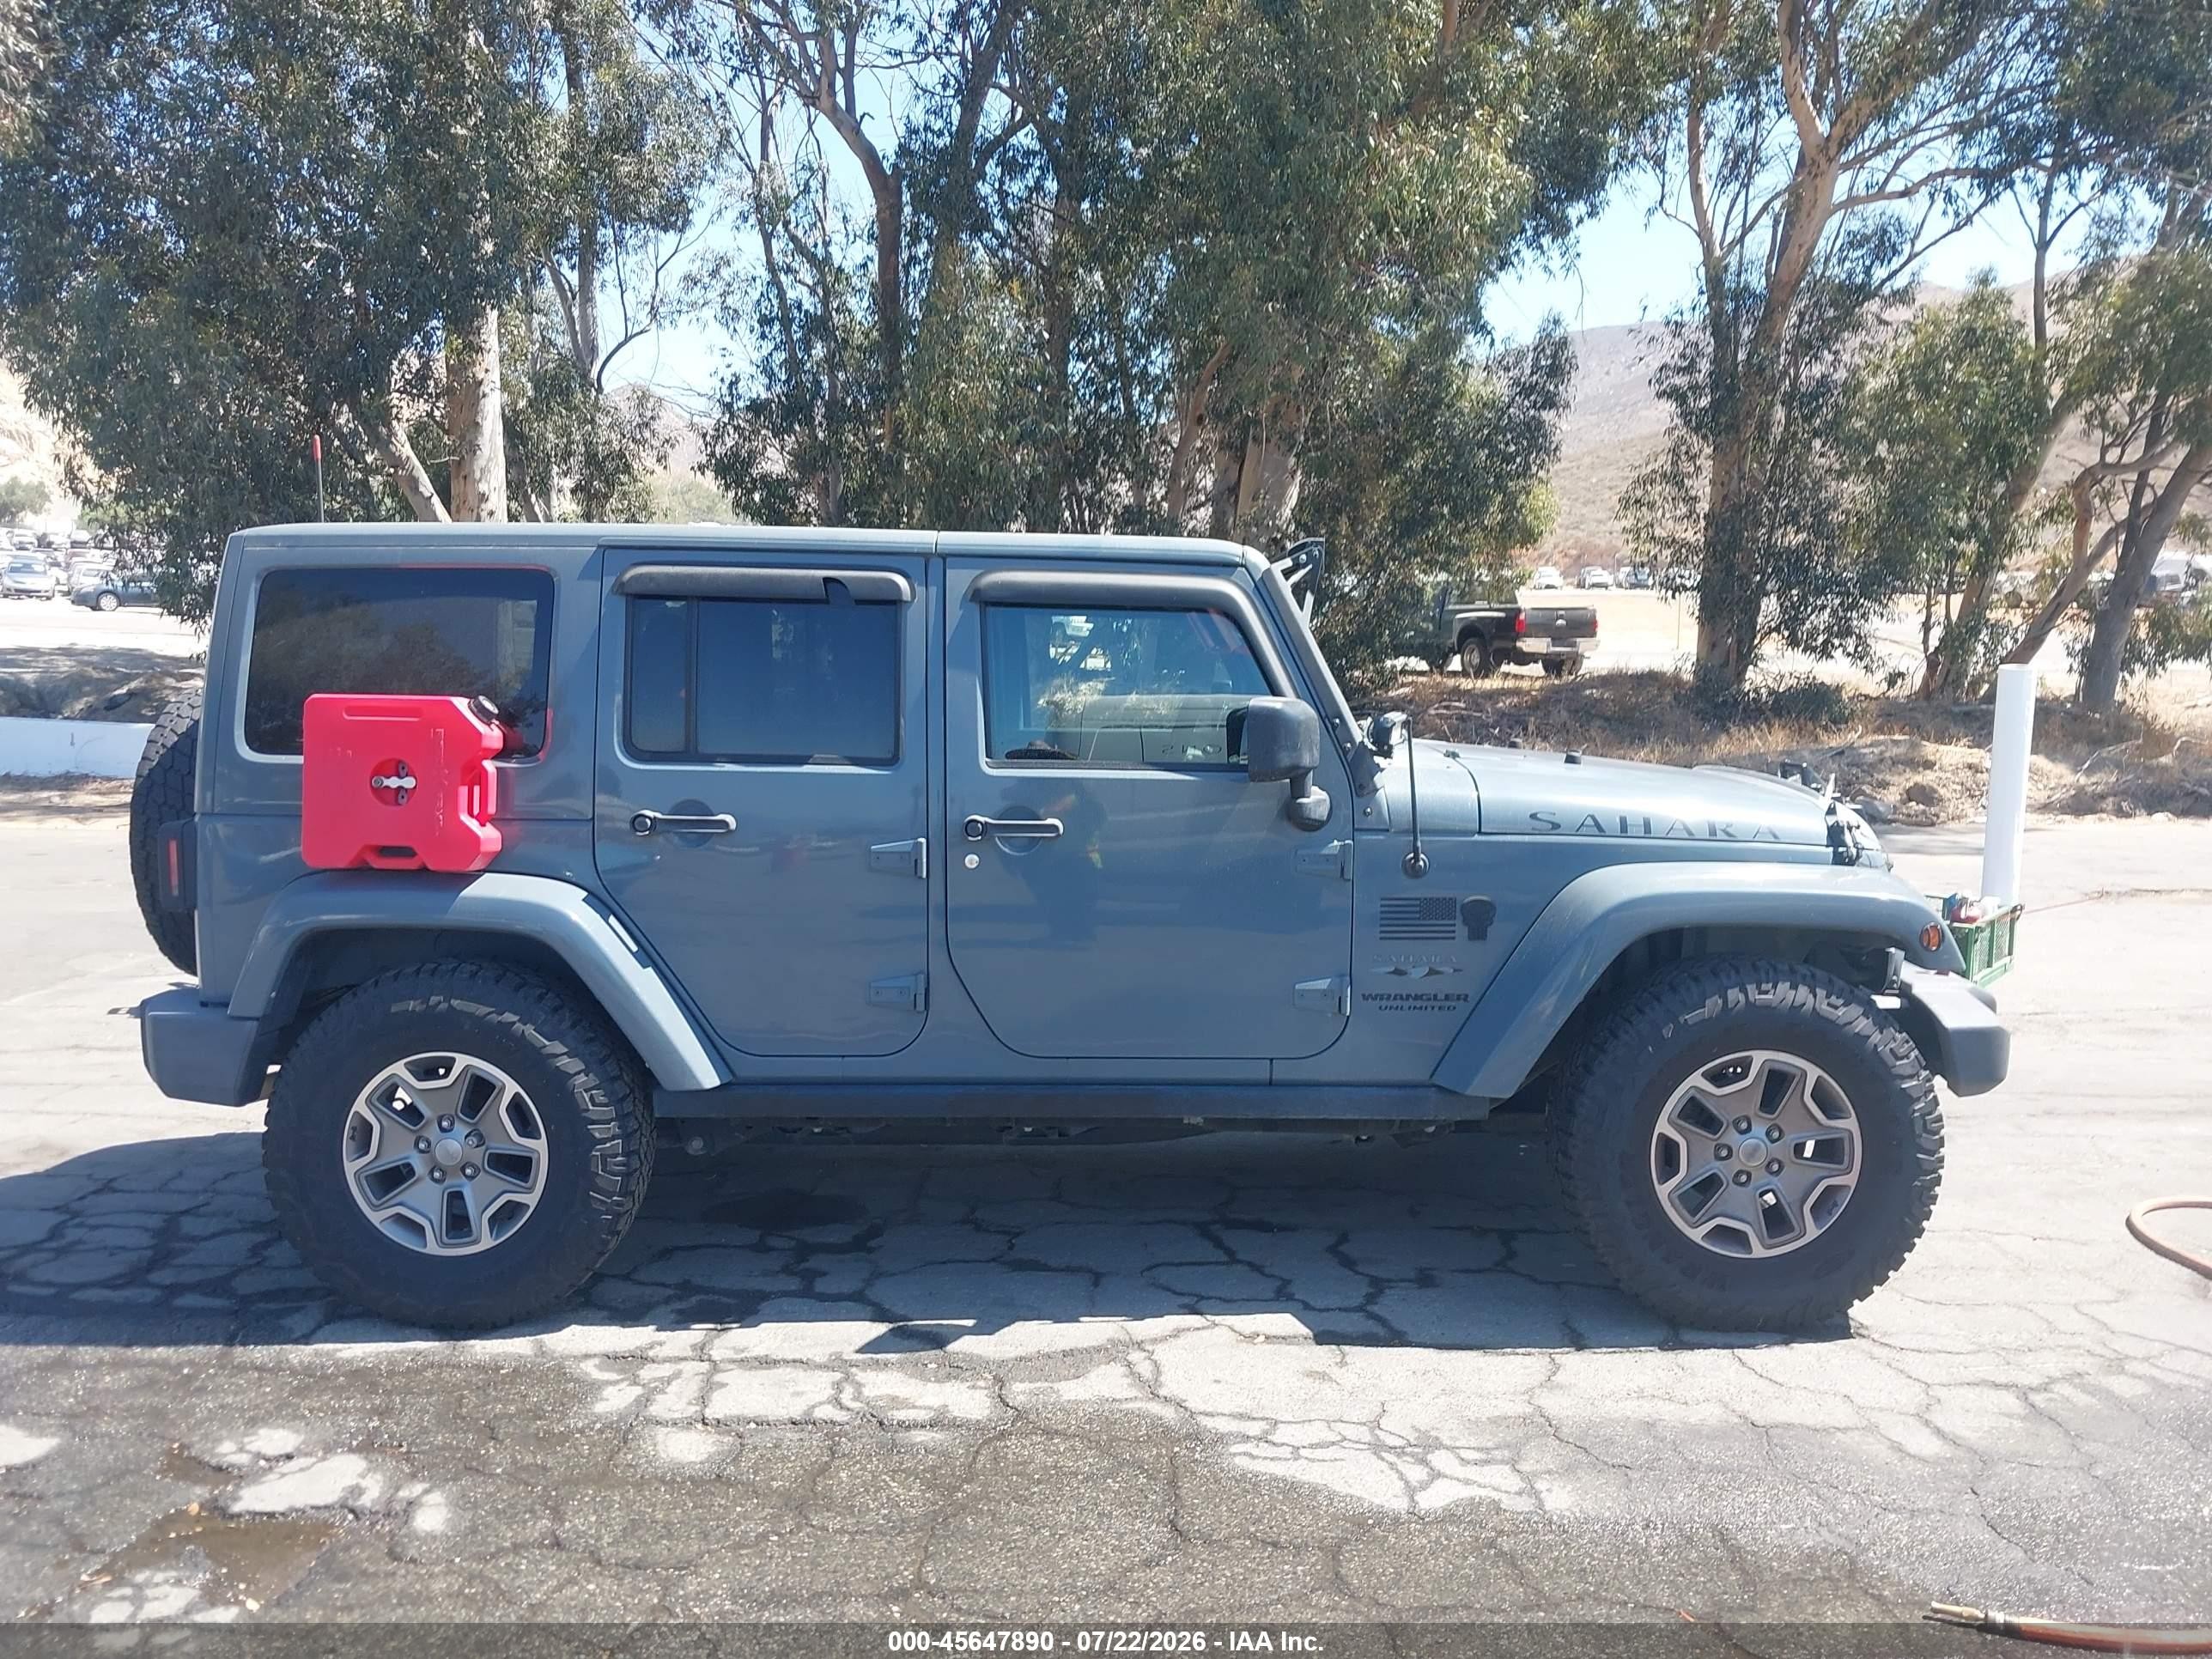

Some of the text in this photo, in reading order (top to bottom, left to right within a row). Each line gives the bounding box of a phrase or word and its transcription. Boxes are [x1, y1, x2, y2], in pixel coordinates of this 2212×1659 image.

[1528, 810, 1781, 841] SAHARA
[1372, 954, 1458, 963] SAHARA
[1361, 993, 1470, 1003] WRANGLER
